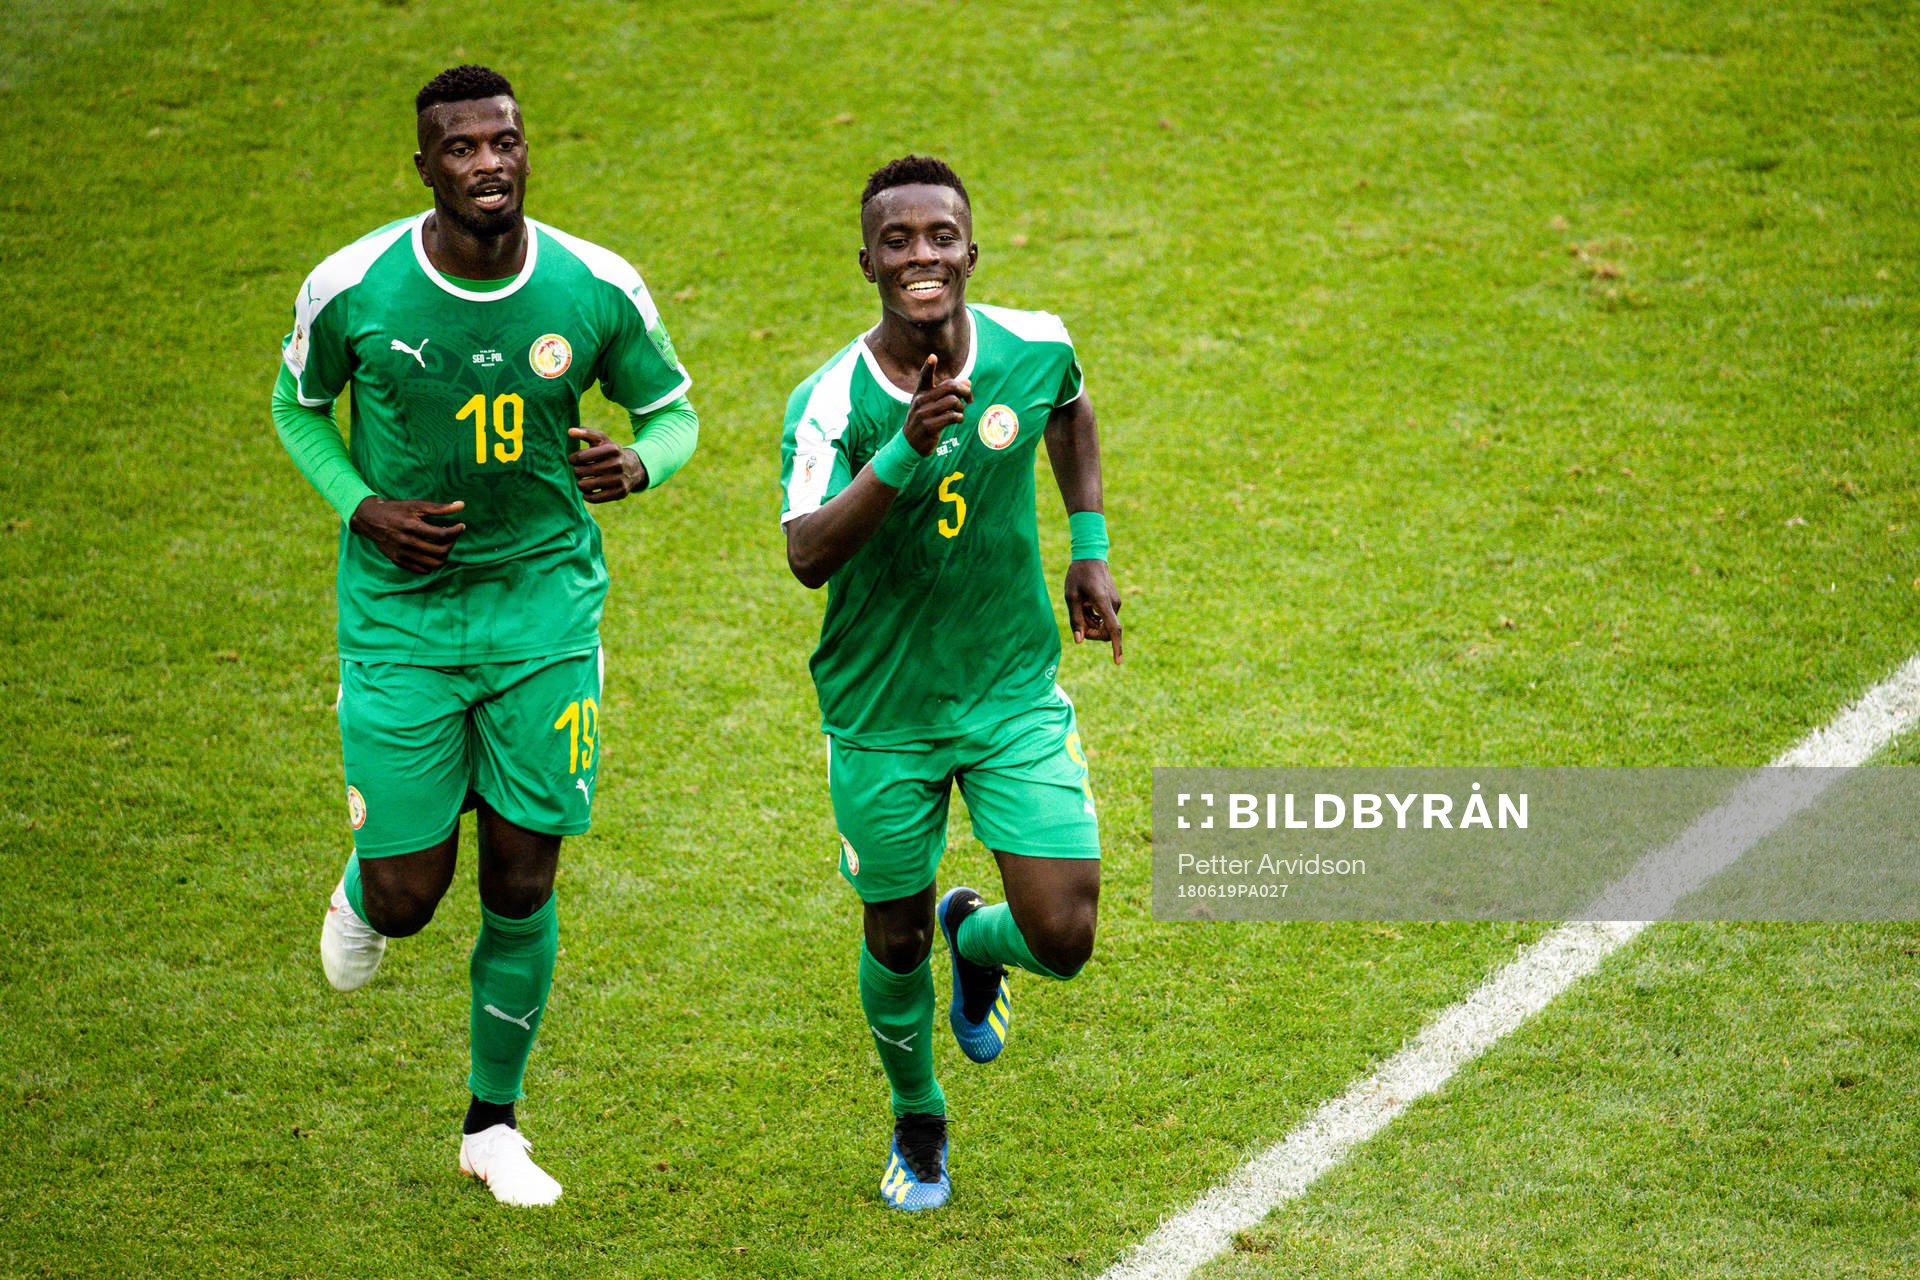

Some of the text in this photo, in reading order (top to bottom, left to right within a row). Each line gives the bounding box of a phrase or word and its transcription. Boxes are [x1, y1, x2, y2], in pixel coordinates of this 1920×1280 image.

[455, 393, 524, 464] 19
[938, 471, 967, 539] 5
[554, 697, 599, 774] 19
